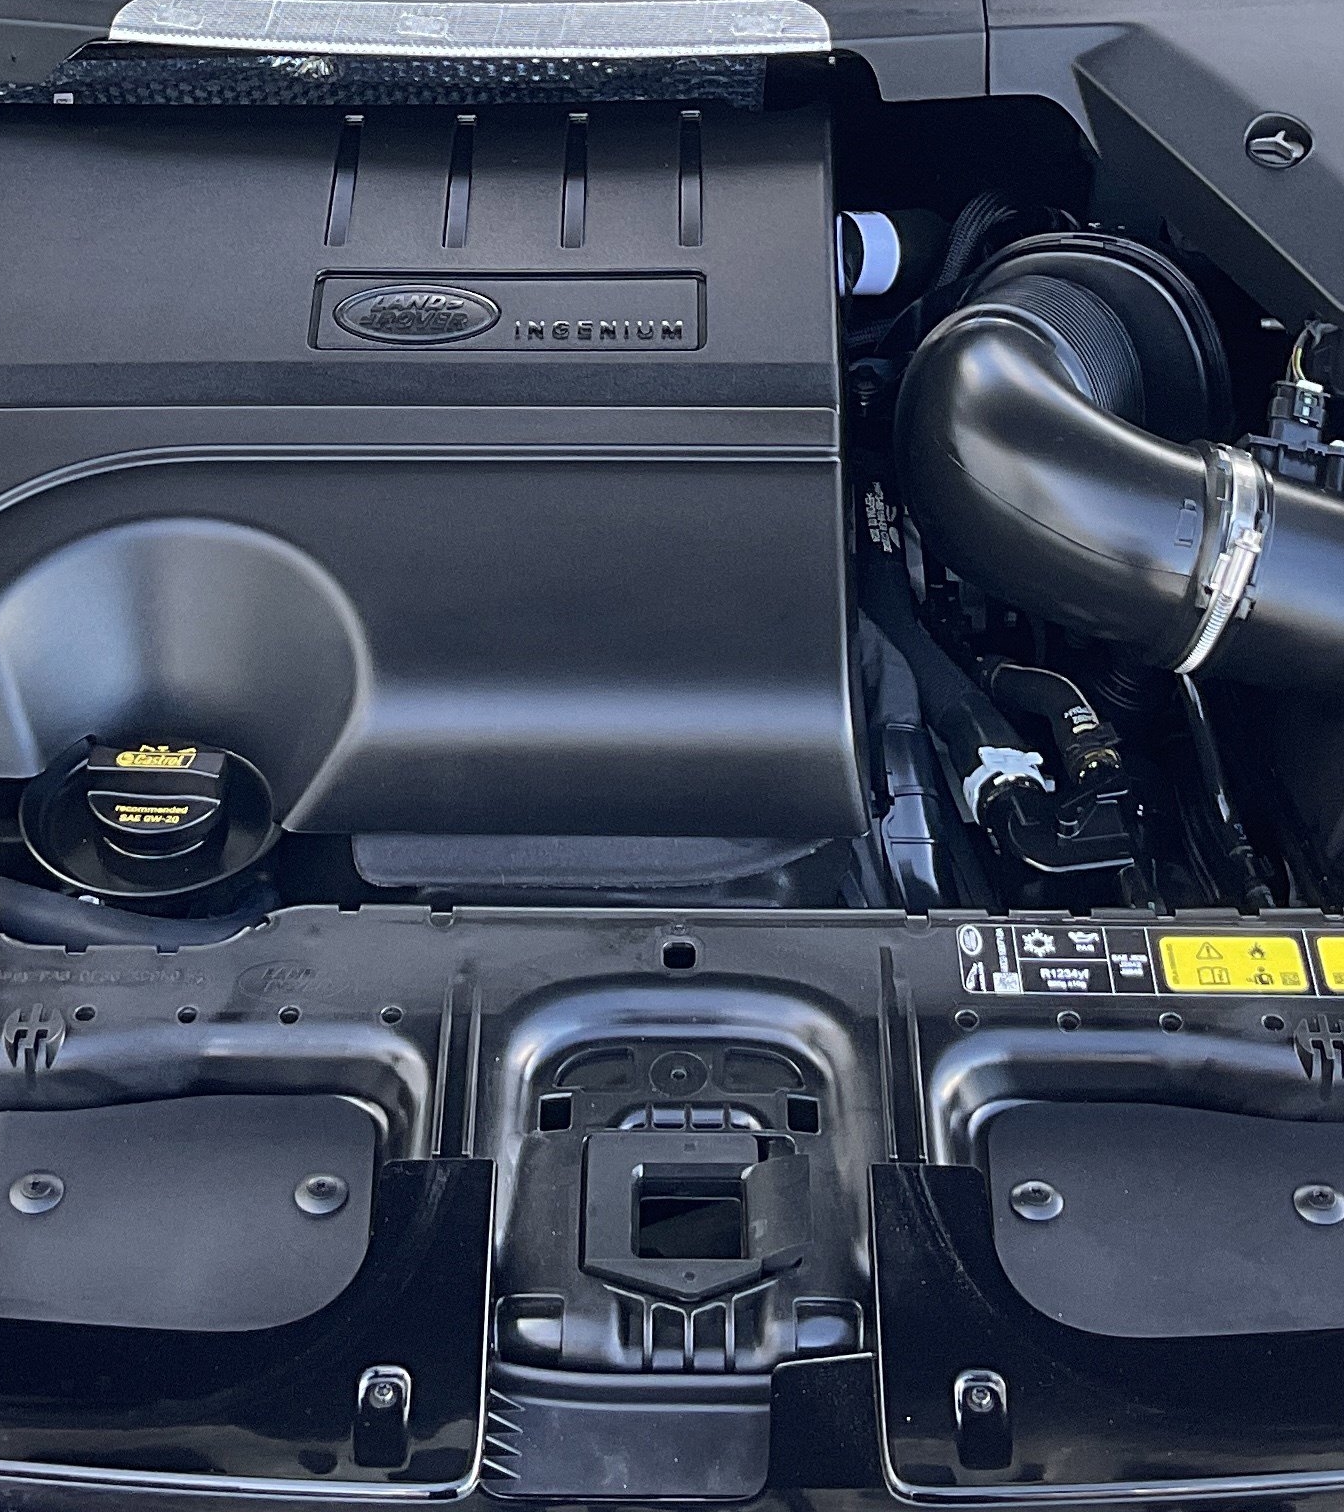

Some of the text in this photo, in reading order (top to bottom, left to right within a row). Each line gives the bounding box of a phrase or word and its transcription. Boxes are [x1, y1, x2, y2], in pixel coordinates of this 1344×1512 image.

[370, 293, 450, 312] LAND
[377, 311, 469, 332] ROVER
[514, 319, 684, 341] INGENIUM
[134, 753, 184, 767] Castrol
[115, 805, 189, 815] recommended
[119, 814, 141, 823] SAE
[1040, 968, 1089, 980] R1234yf
